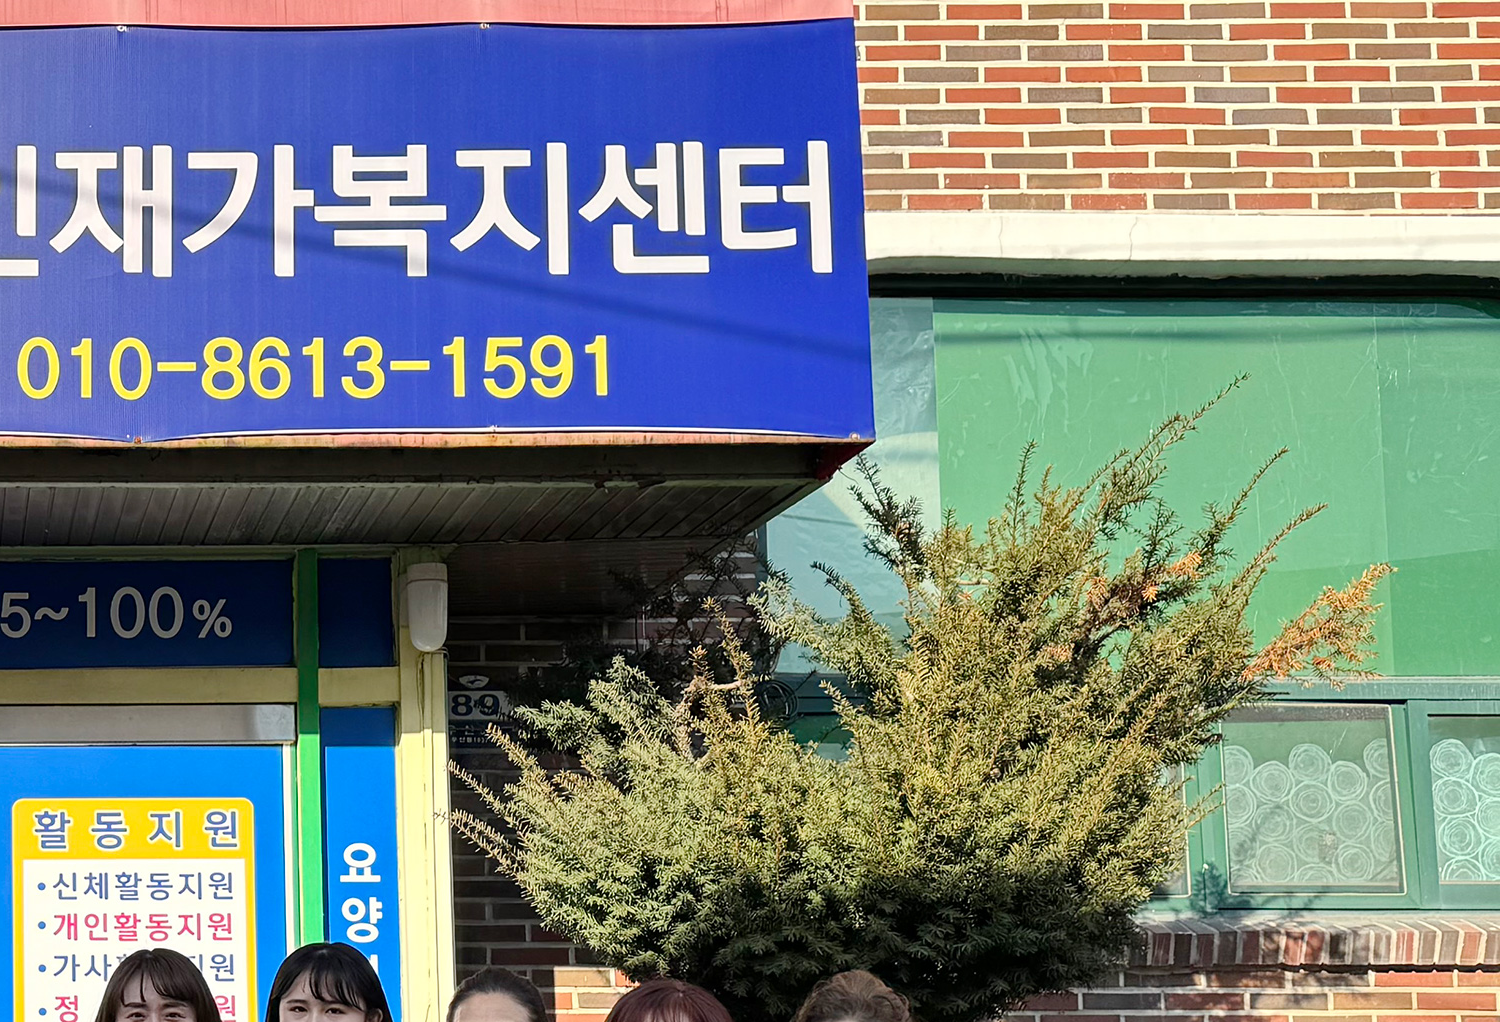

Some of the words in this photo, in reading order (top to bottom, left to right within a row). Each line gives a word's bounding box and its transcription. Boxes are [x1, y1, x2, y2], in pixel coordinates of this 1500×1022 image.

[15, 333, 611, 400] 010-8613-1591
[451, 694, 500, 717] 89
[33, 809, 240, 850] 활동지원
[51, 871, 235, 902] 신체활동지원
[52, 911, 234, 943] 개인활동지원
[339, 842, 384, 976] 요양
